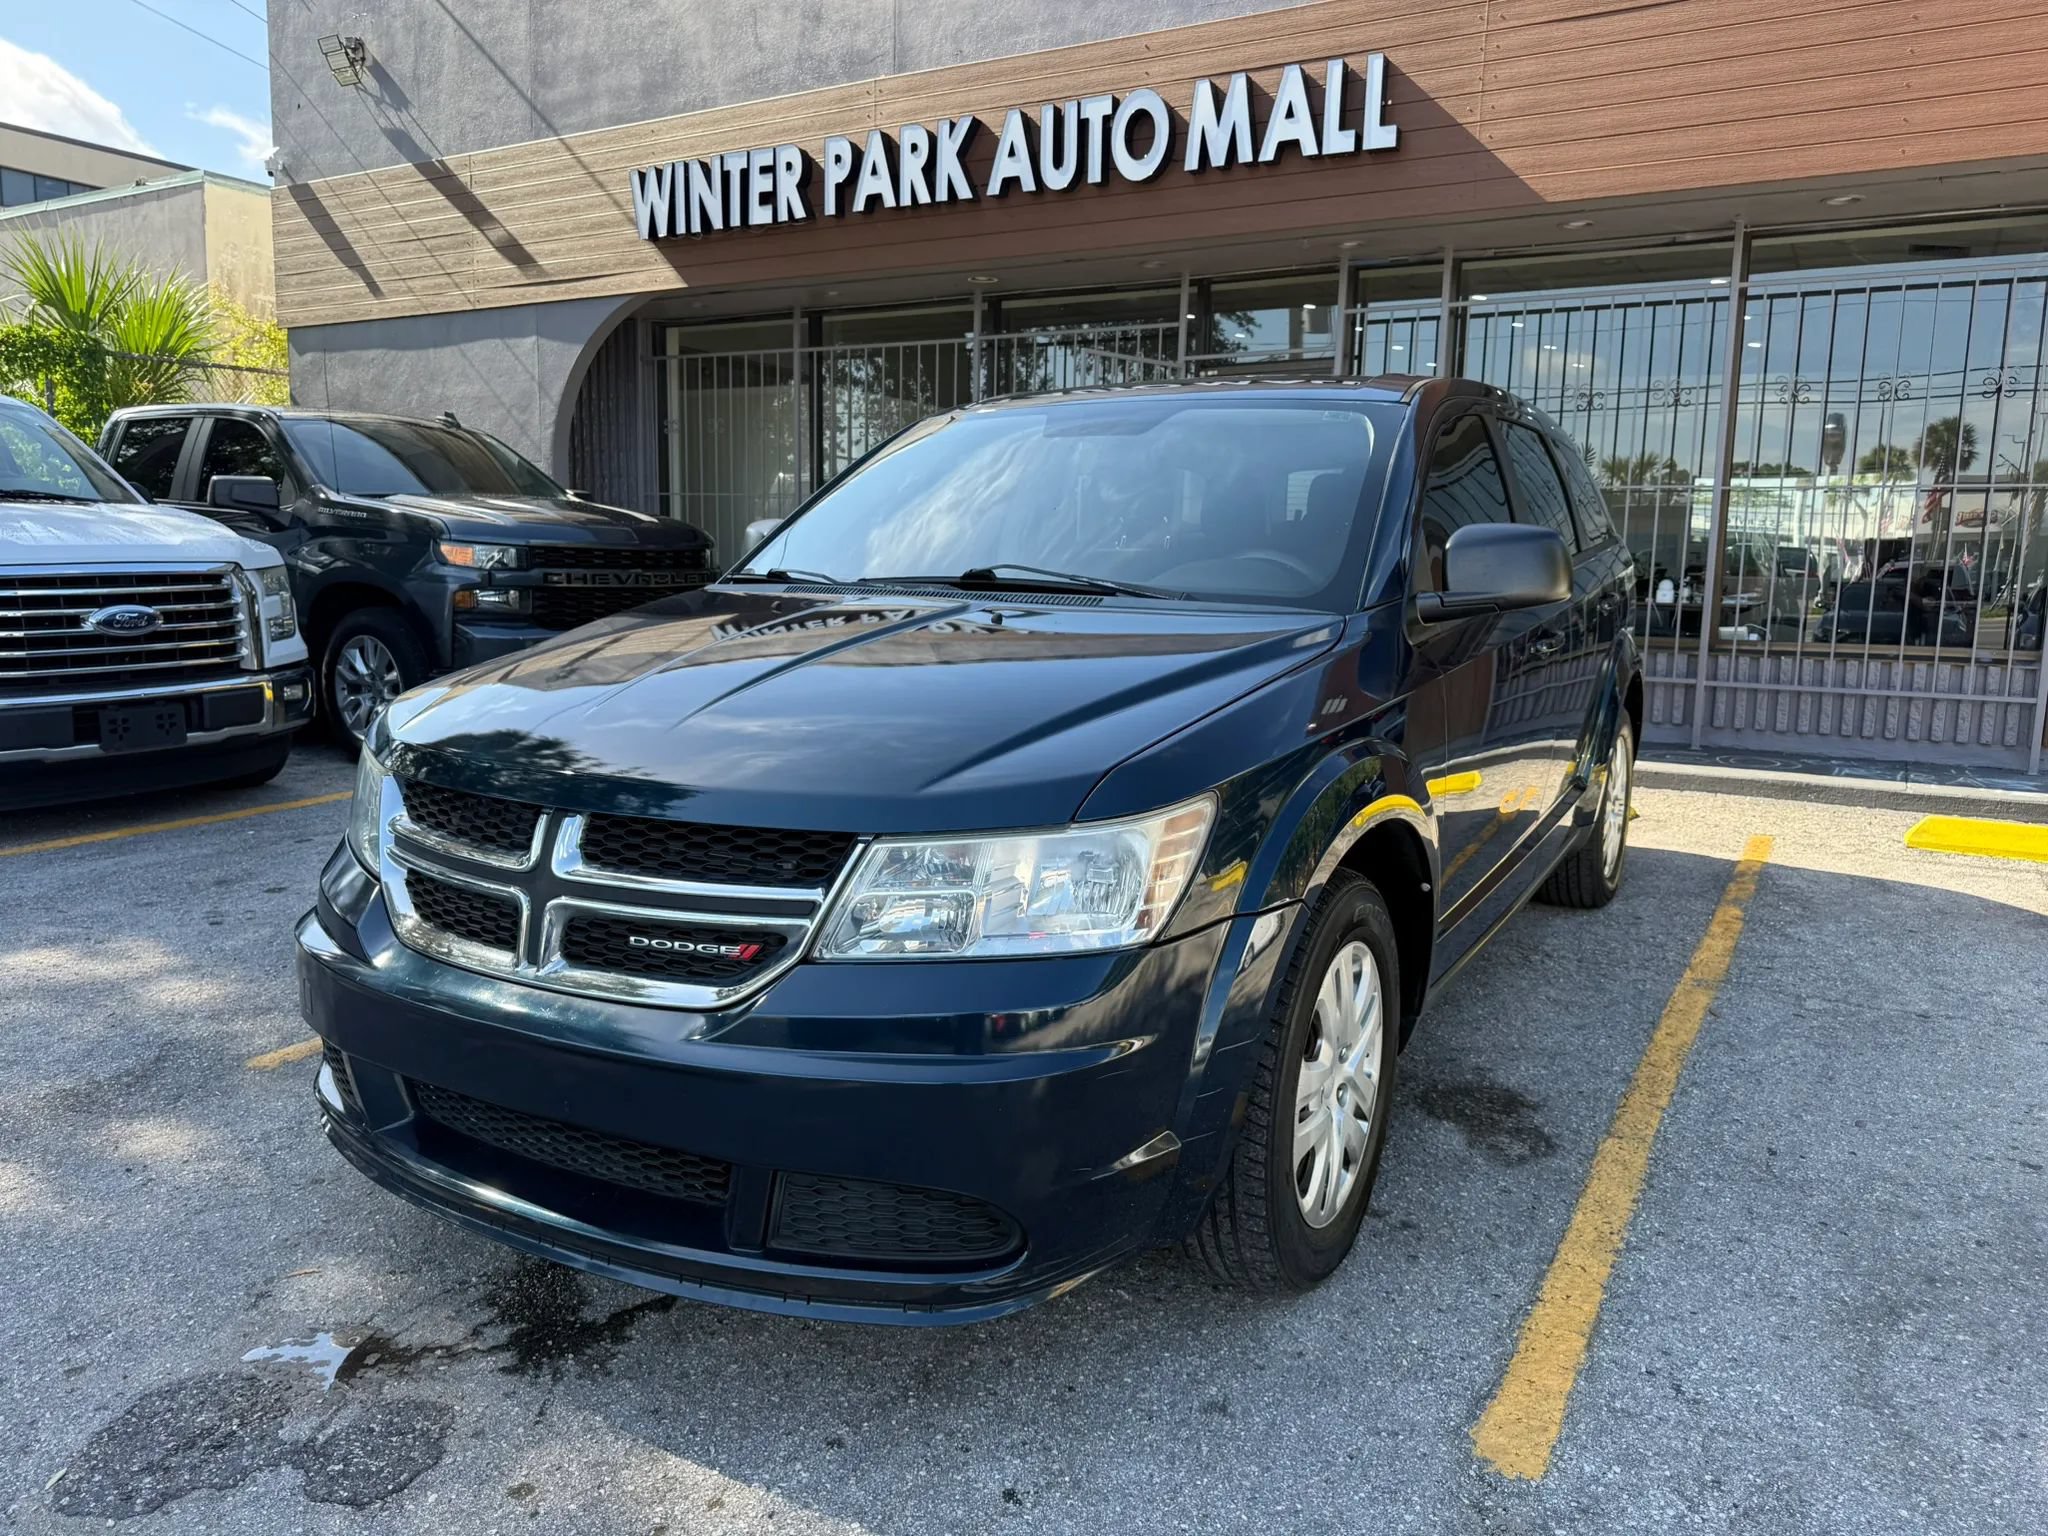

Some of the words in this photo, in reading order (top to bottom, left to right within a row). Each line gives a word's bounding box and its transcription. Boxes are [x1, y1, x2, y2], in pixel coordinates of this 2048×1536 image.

[629, 143, 810, 241] WINTER
[823, 115, 976, 216] PARK
[986, 88, 1172, 197] AUTO
[1184, 52, 1400, 173] MALL
[542, 571, 710, 585] CHEVROLET
[112, 612, 149, 628] Ford
[629, 936, 742, 956] DODGE
